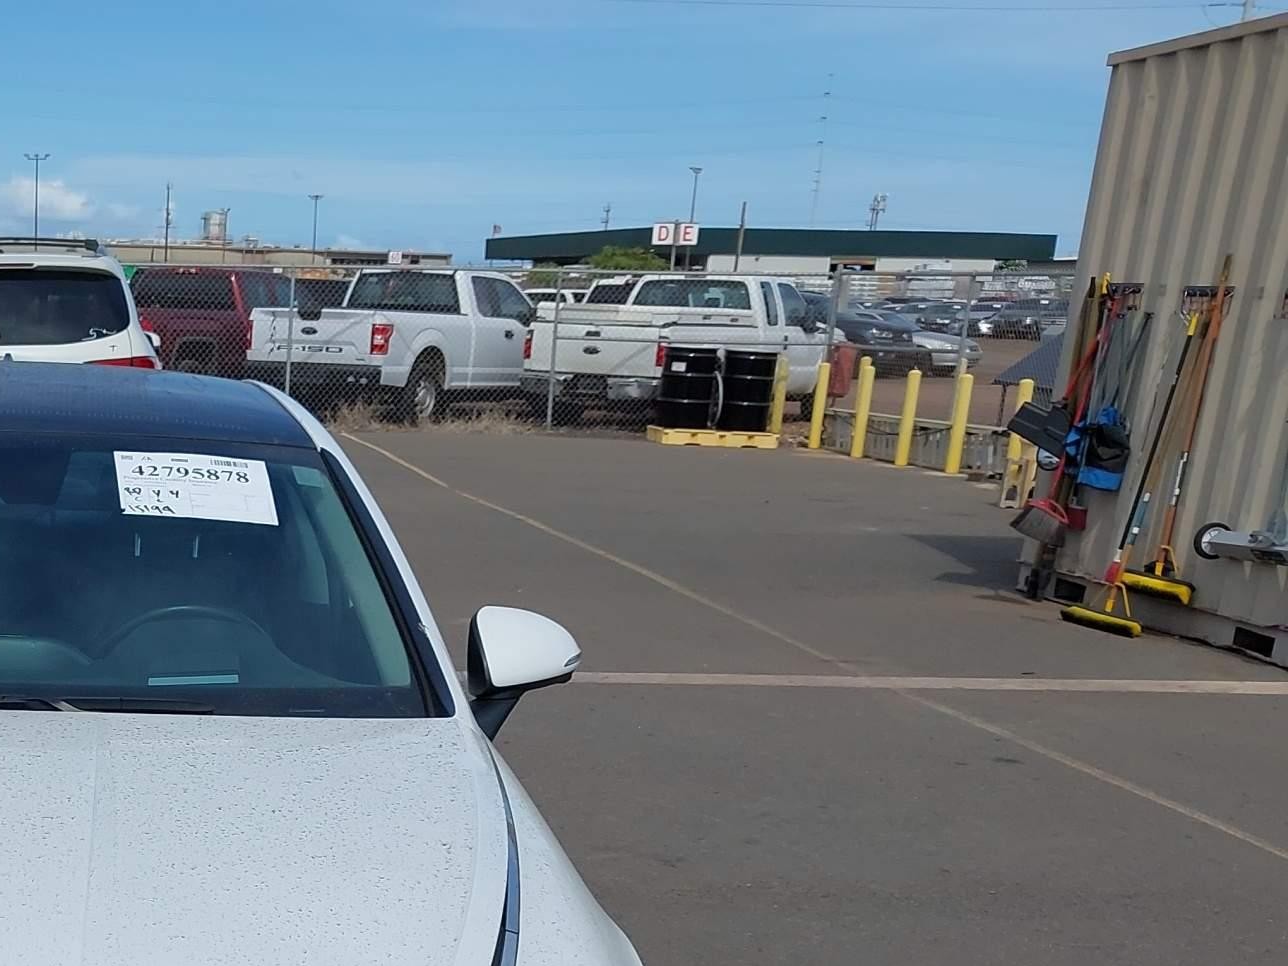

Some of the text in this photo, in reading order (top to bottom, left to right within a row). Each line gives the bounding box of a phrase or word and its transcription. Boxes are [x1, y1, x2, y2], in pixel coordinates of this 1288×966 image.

[658, 226, 694, 241] D E
[131, 465, 250, 484] 42795878
